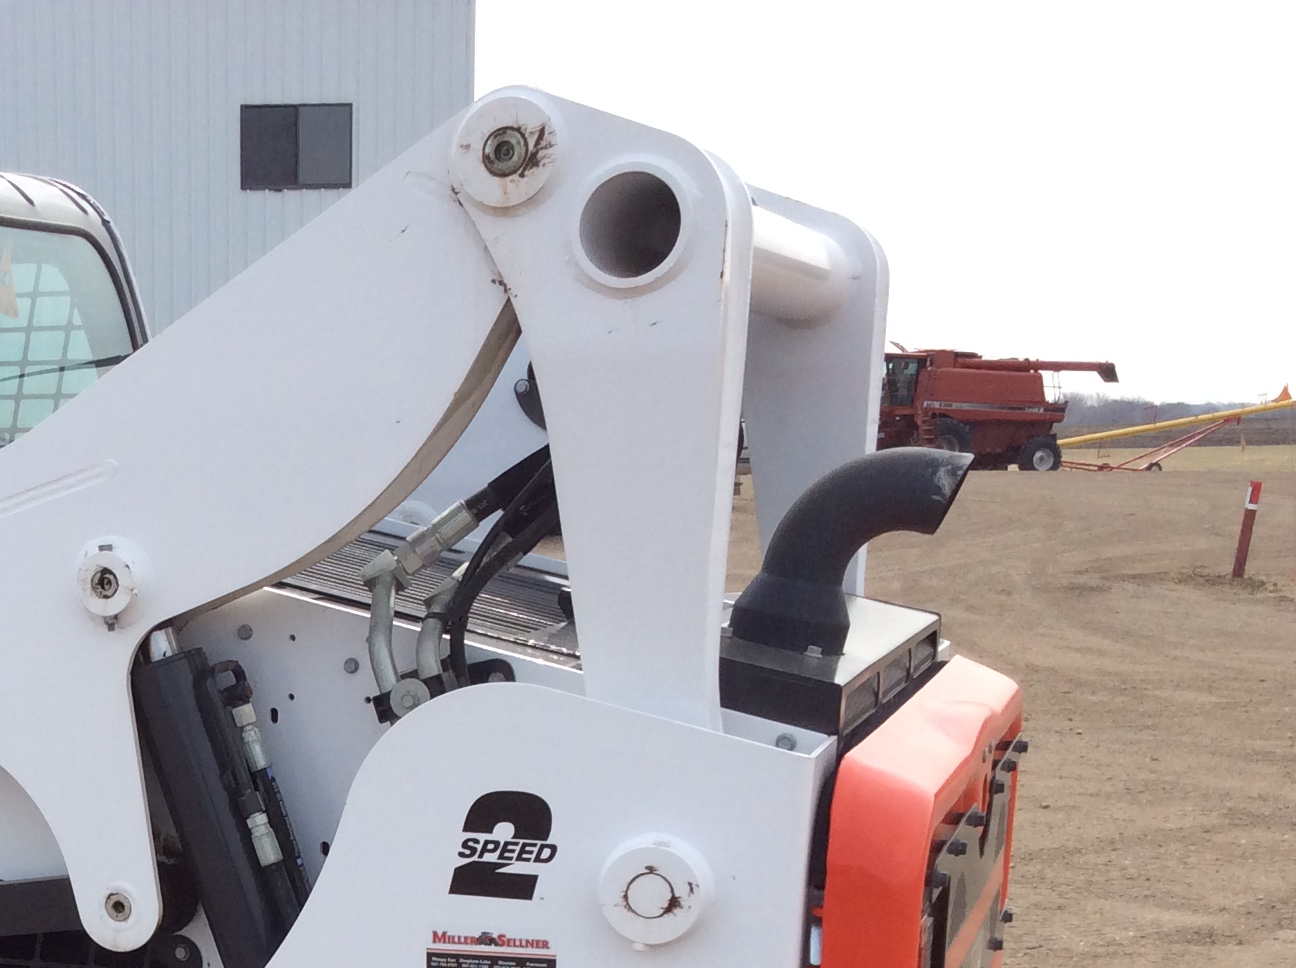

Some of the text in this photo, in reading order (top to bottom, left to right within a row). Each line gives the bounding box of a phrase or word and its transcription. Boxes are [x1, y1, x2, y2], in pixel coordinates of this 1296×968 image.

[448, 790, 553, 901] 2
[457, 837, 558, 865] SPEED
[497, 934, 550, 949] SELLNER
